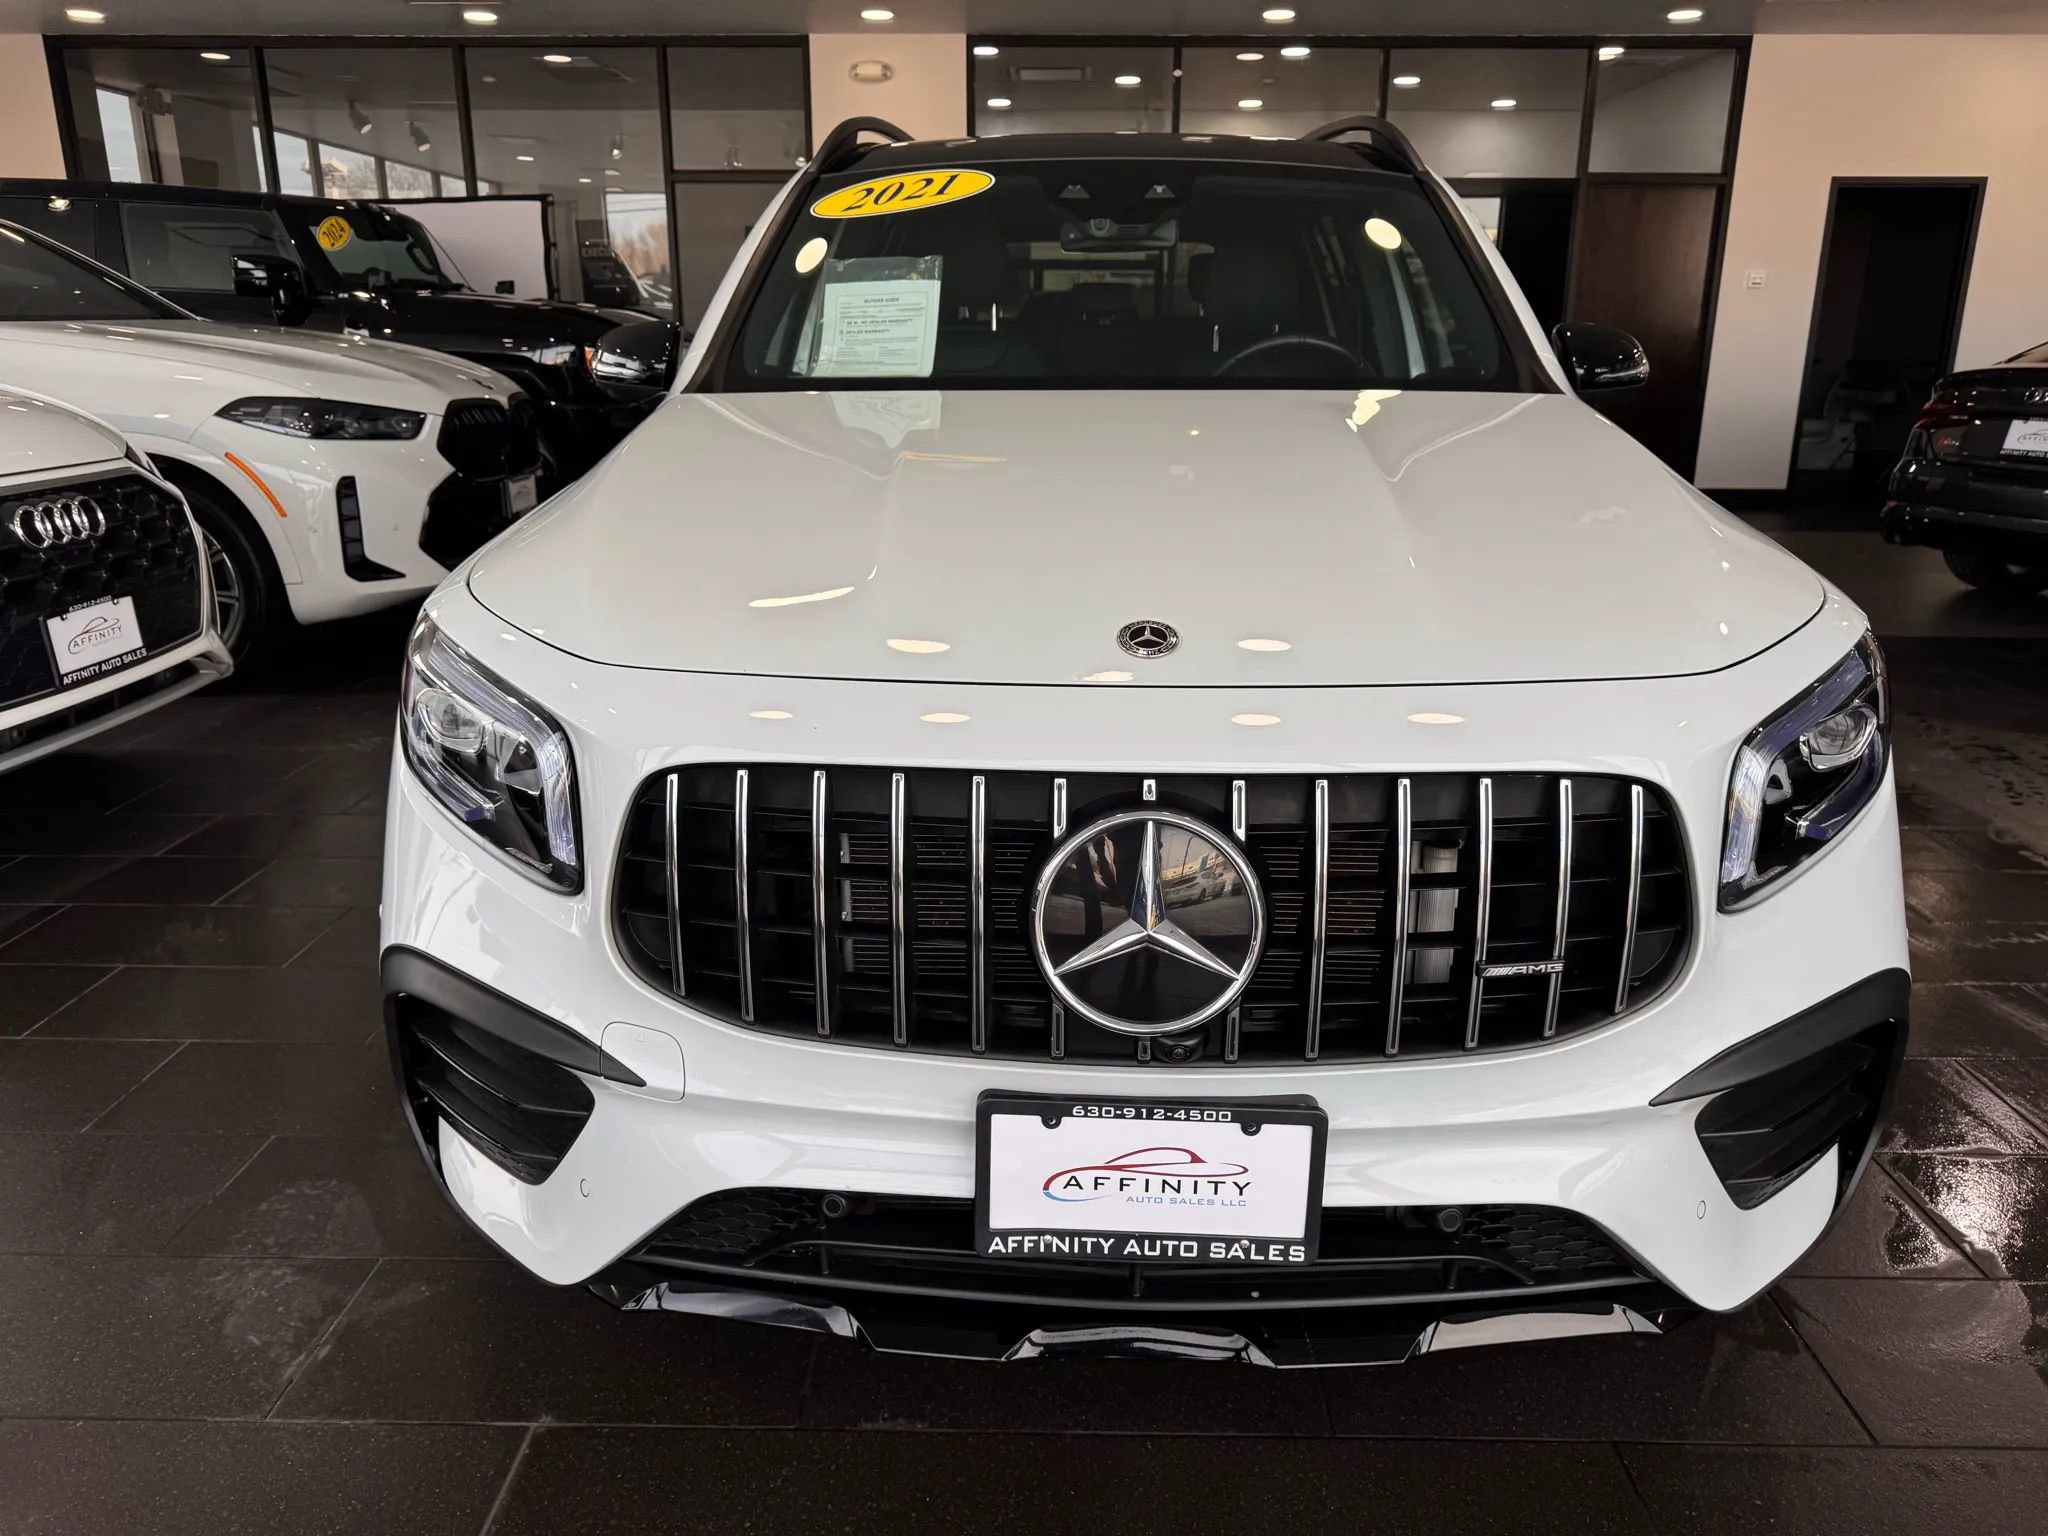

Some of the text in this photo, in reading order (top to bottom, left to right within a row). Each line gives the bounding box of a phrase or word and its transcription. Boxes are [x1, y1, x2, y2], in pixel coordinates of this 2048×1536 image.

[841, 174, 960, 212] 2021
[322, 219, 346, 248] 2024
[73, 624, 122, 648] AFFINITY
[63, 648, 147, 685] AFFINITY AUTO SALES
[1507, 964, 1564, 975] AMG
[1072, 1105, 1232, 1122] 630-912-4500
[1062, 1175, 1252, 1197] AFFINITY
[1126, 1195, 1246, 1207] AUTO SALES LLC
[988, 1235, 1305, 1262] AFFINITY AUTO SALES
